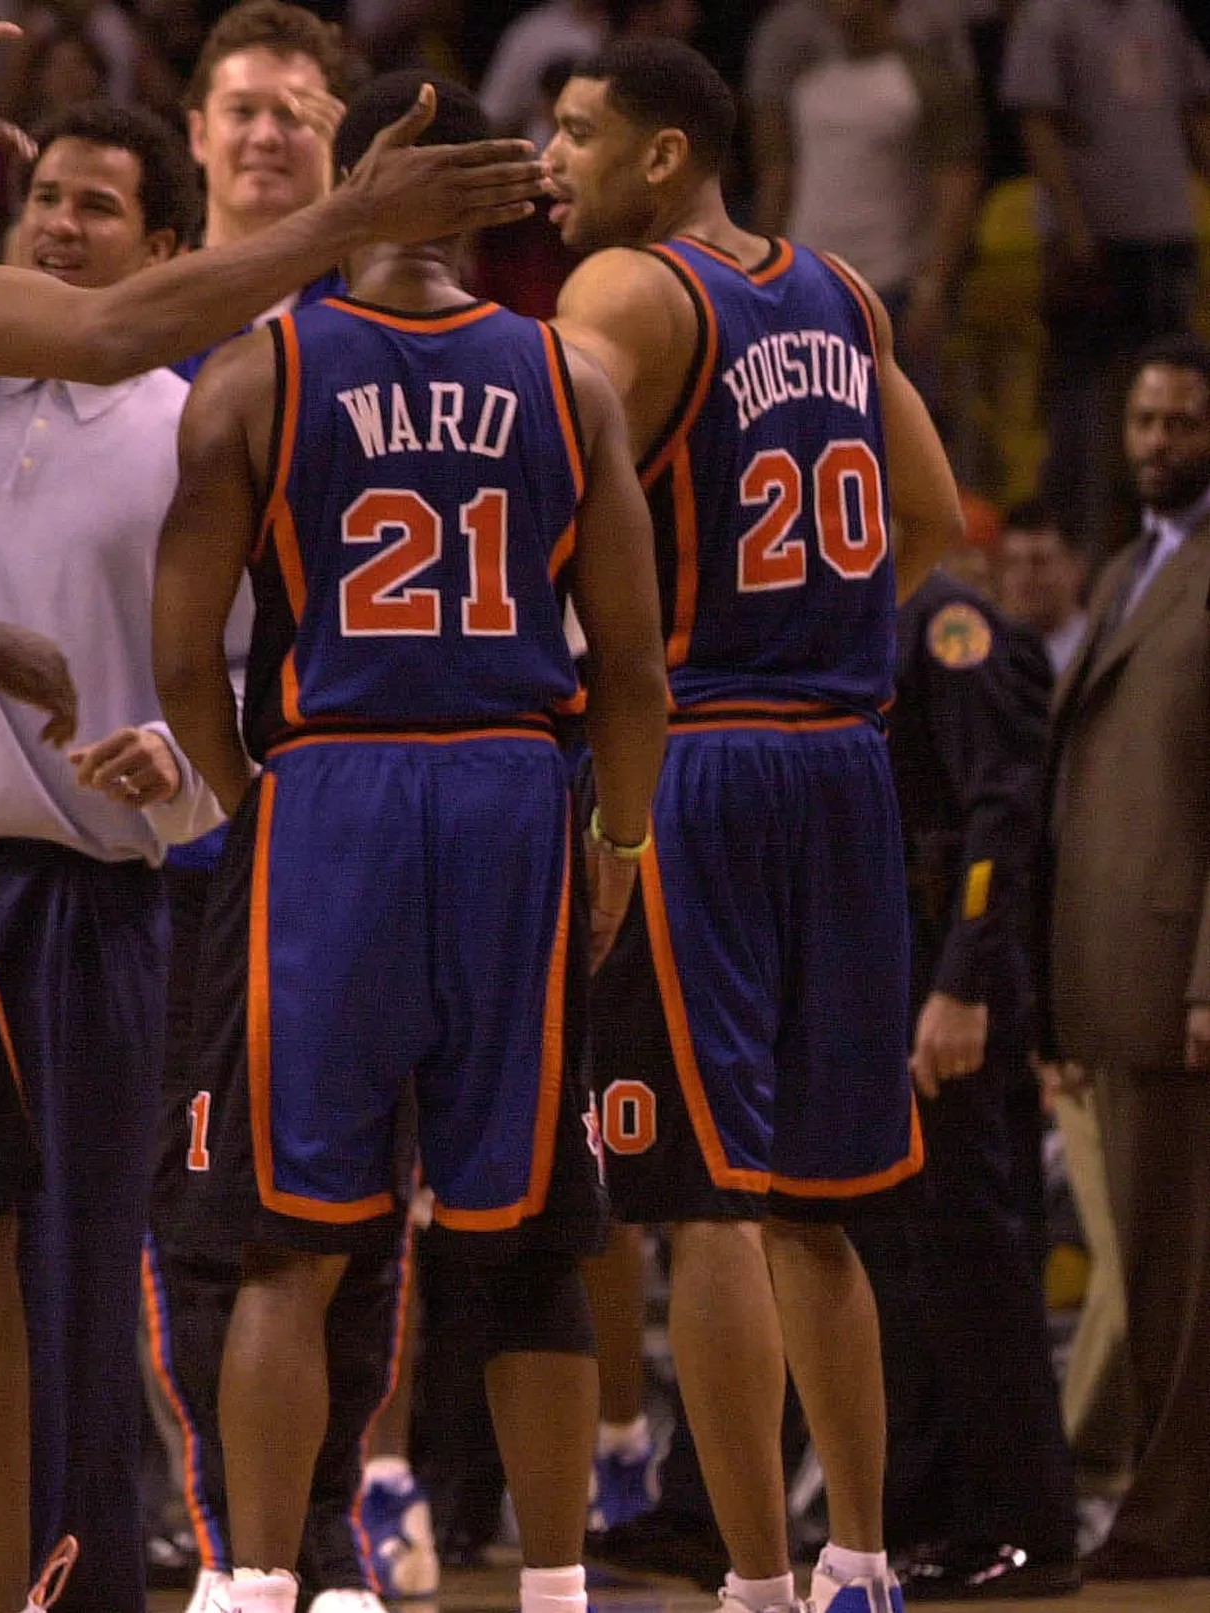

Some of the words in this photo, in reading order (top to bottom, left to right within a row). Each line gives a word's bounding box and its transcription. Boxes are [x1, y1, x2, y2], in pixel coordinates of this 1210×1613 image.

[336, 381, 518, 459] WARD
[722, 329, 872, 431] HOUSTON
[340, 488, 517, 637] 21
[737, 438, 887, 593] 20
